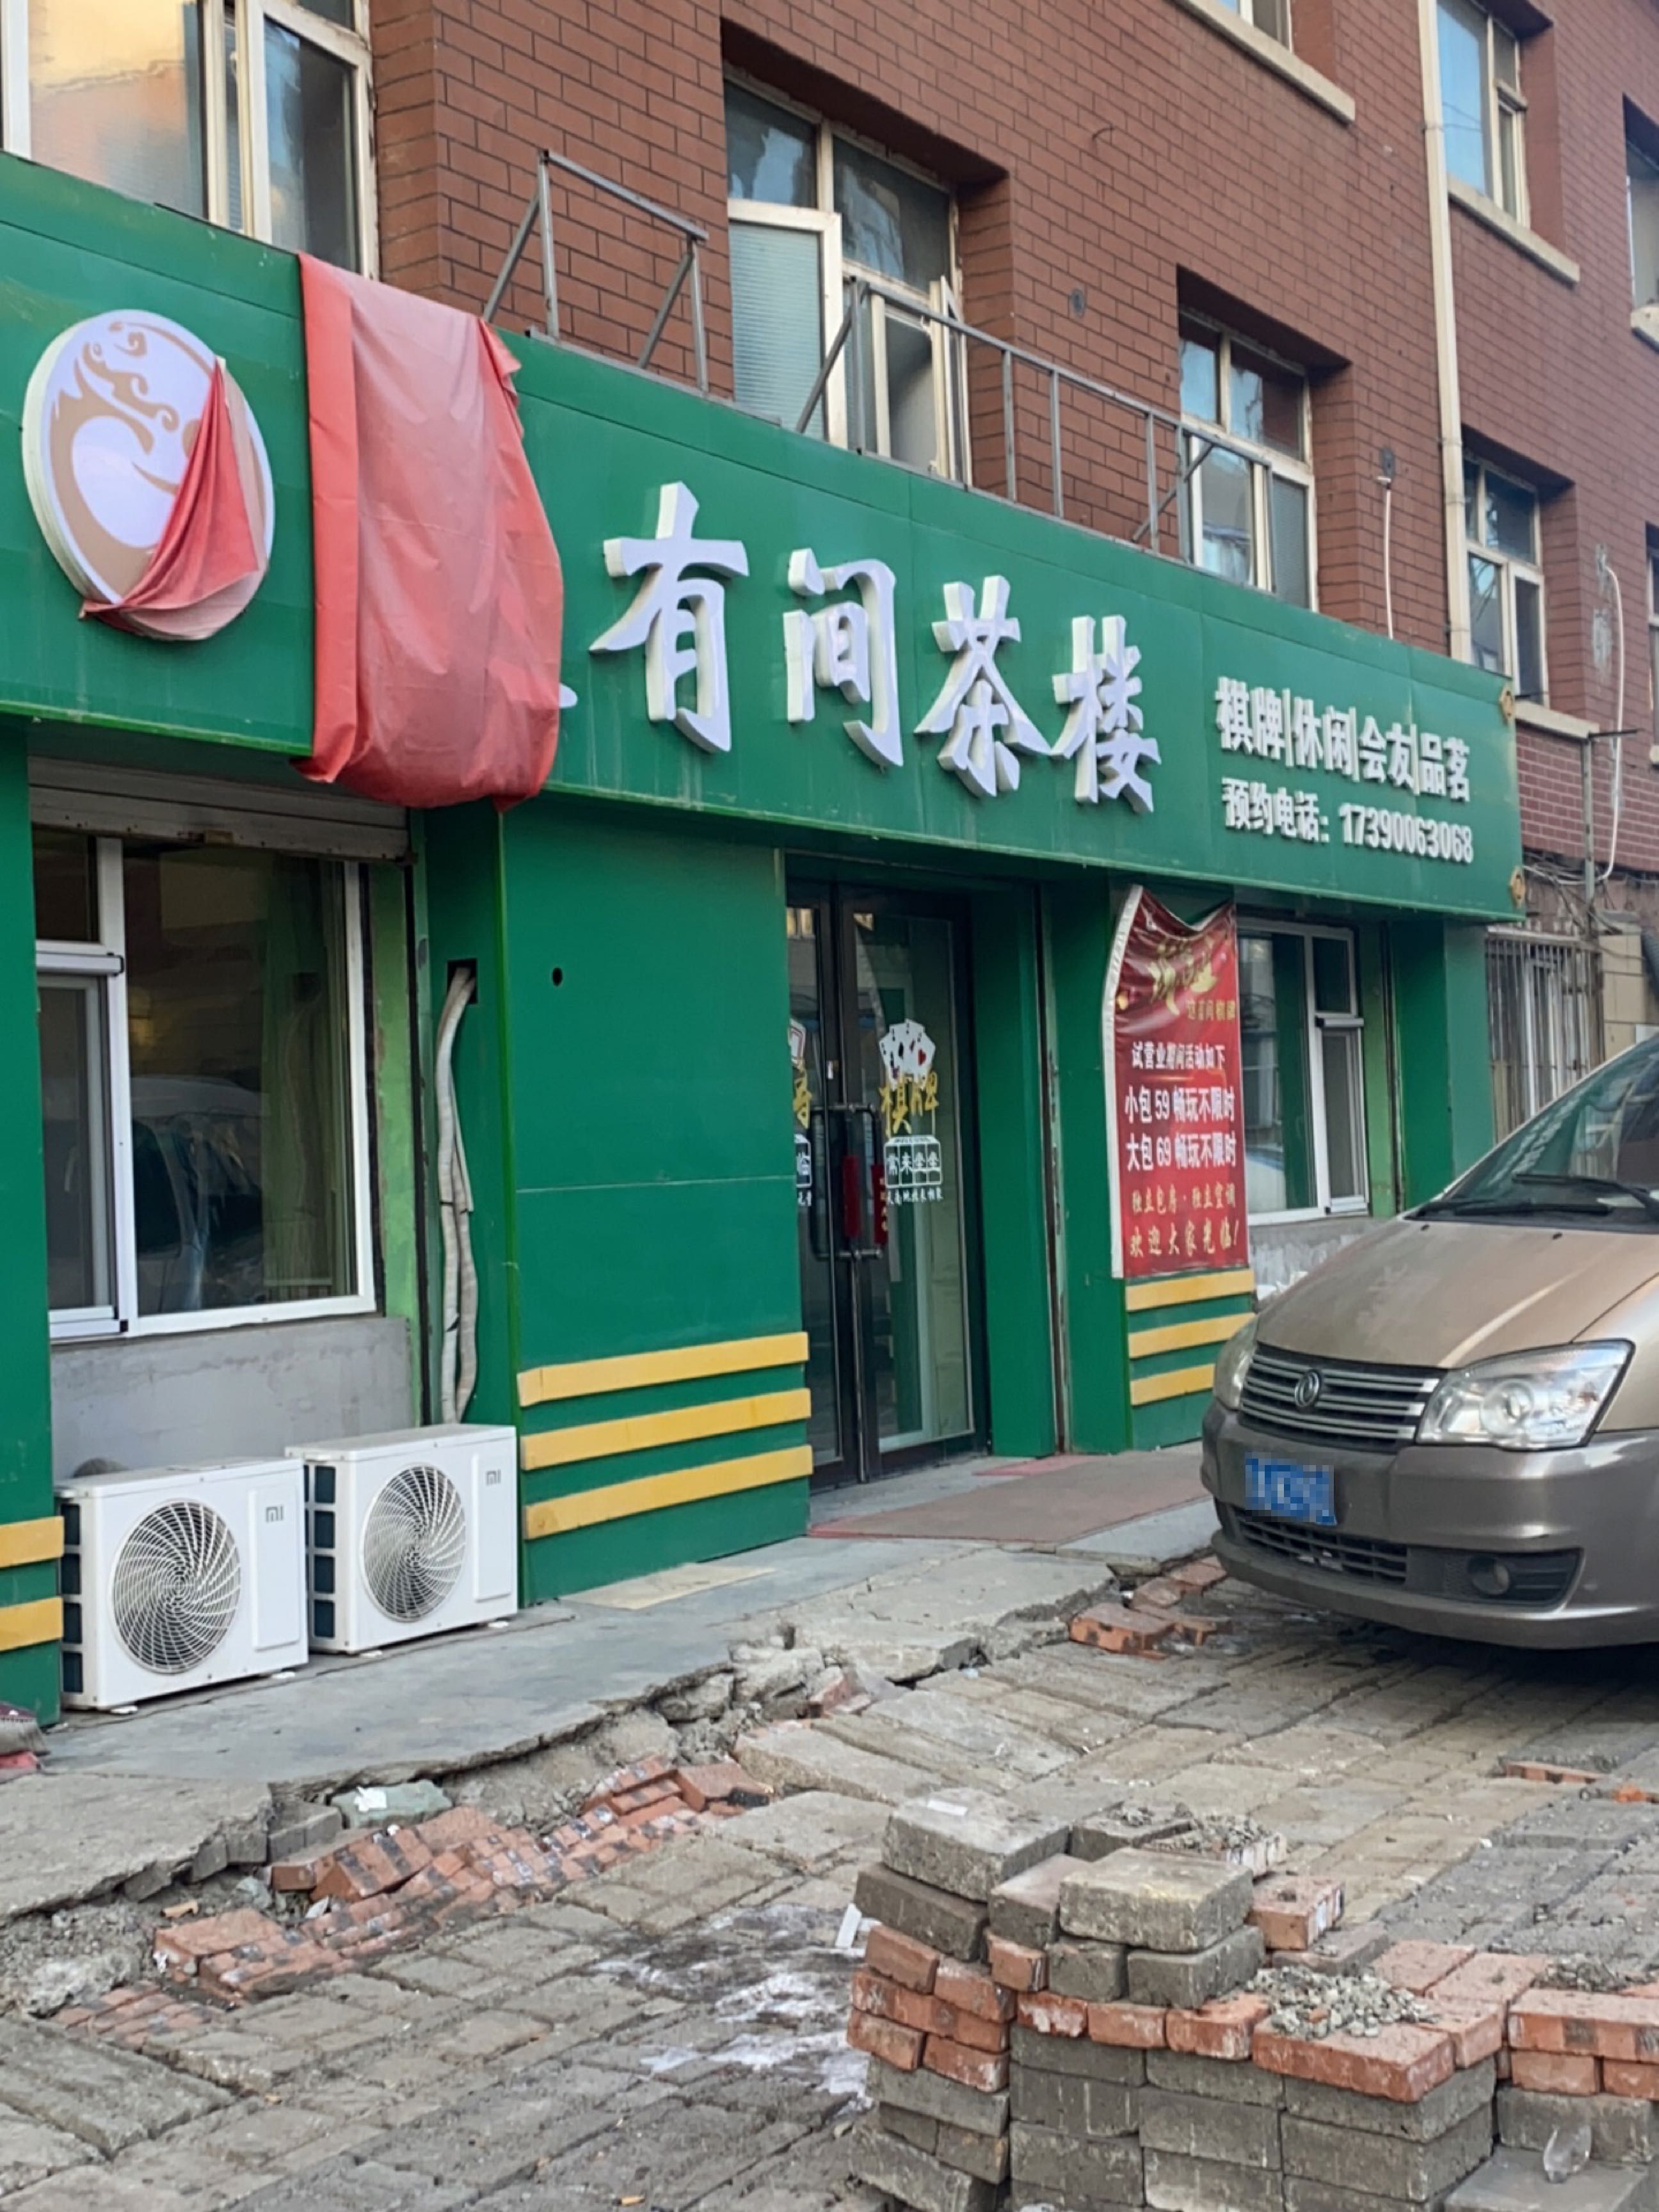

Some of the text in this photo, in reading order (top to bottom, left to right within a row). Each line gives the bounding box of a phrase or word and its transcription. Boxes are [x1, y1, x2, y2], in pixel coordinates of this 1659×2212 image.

[559, 481, 1162, 813] 有间茶楼
[1132, 1040, 1226, 1070] 试营业期间活动如下
